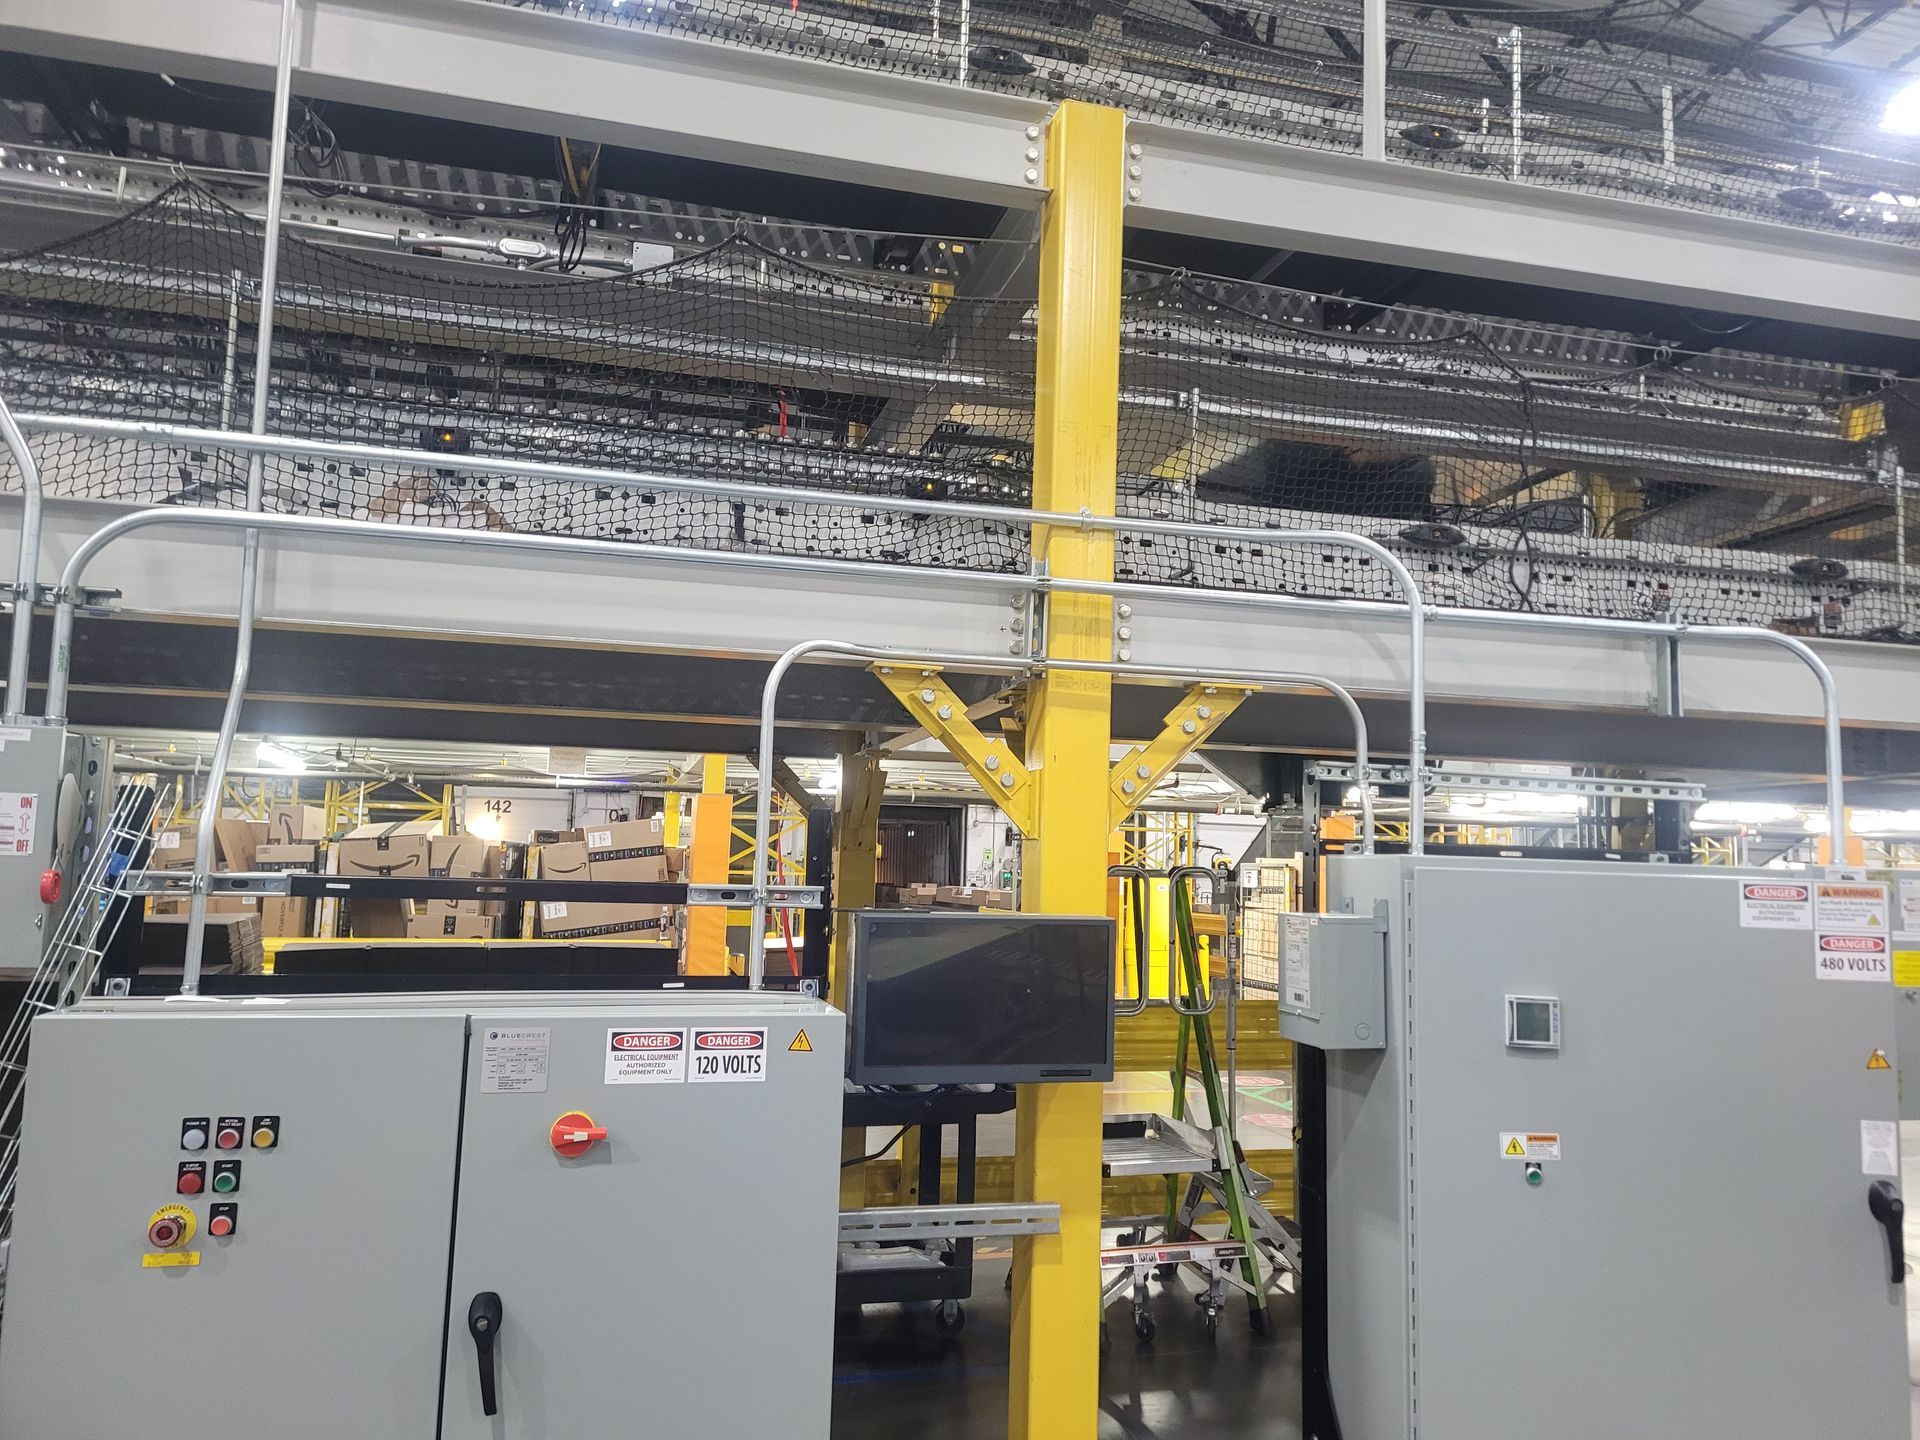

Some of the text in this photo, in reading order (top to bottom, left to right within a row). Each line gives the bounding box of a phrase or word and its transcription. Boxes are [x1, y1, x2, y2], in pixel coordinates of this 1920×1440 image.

[20, 797, 33, 809] ON
[484, 799, 512, 813] 142
[16, 839, 30, 852] OFF
[1753, 888, 1798, 898] DANGER
[1832, 888, 1880, 898] WARNING
[1829, 939, 1874, 949] DANGER
[1821, 957, 1844, 970] 480
[1847, 957, 1886, 971] VOLTS
[623, 1036, 671, 1047] DANGER
[707, 1036, 751, 1046] DANGER
[646, 1053, 679, 1061] EQUIPMENT
[696, 1055, 762, 1074] 120 VOLTS
[157, 1204, 191, 1215] EMERGENCY
